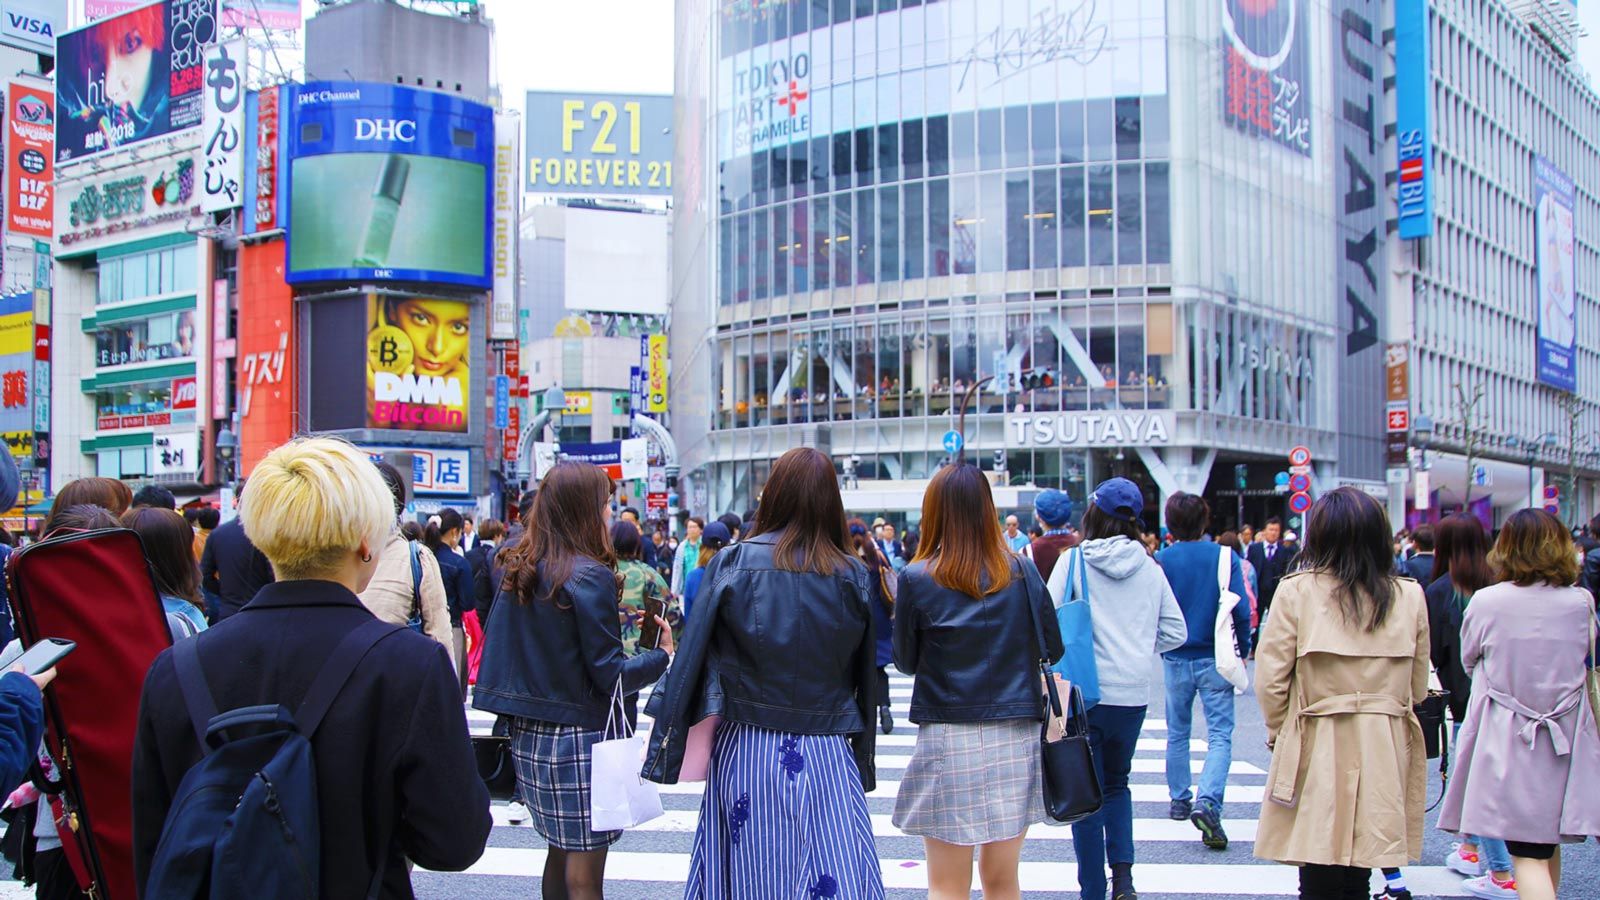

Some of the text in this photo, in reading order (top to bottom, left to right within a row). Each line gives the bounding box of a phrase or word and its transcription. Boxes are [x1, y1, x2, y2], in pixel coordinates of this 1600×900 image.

[7, 12, 52, 38] VISA
[171, 12, 216, 53] GO
[87, 68, 105, 106] hi
[736, 53, 808, 97] TOKYO
[1273, 74, 1300, 108] フジ
[298, 89, 360, 104] DHC Channel
[736, 92, 776, 128] ART
[111, 121, 135, 144] 2018
[205, 44, 240, 203] もんじゃ
[355, 119, 416, 142] DHC
[562, 100, 641, 154] F21
[736, 114, 808, 148] SCRAMBLE
[1273, 105, 1310, 149] テレビ
[530, 158, 672, 188] FOREVER 21
[496, 145, 512, 277] Taisei neon
[374, 269, 393, 279] DHC
[242, 331, 288, 417] クスリ
[374, 371, 463, 406] DMM
[174, 380, 196, 405] JTB
[374, 401, 463, 426] Bitcoin
[1011, 415, 1168, 444] TSUTAYA
